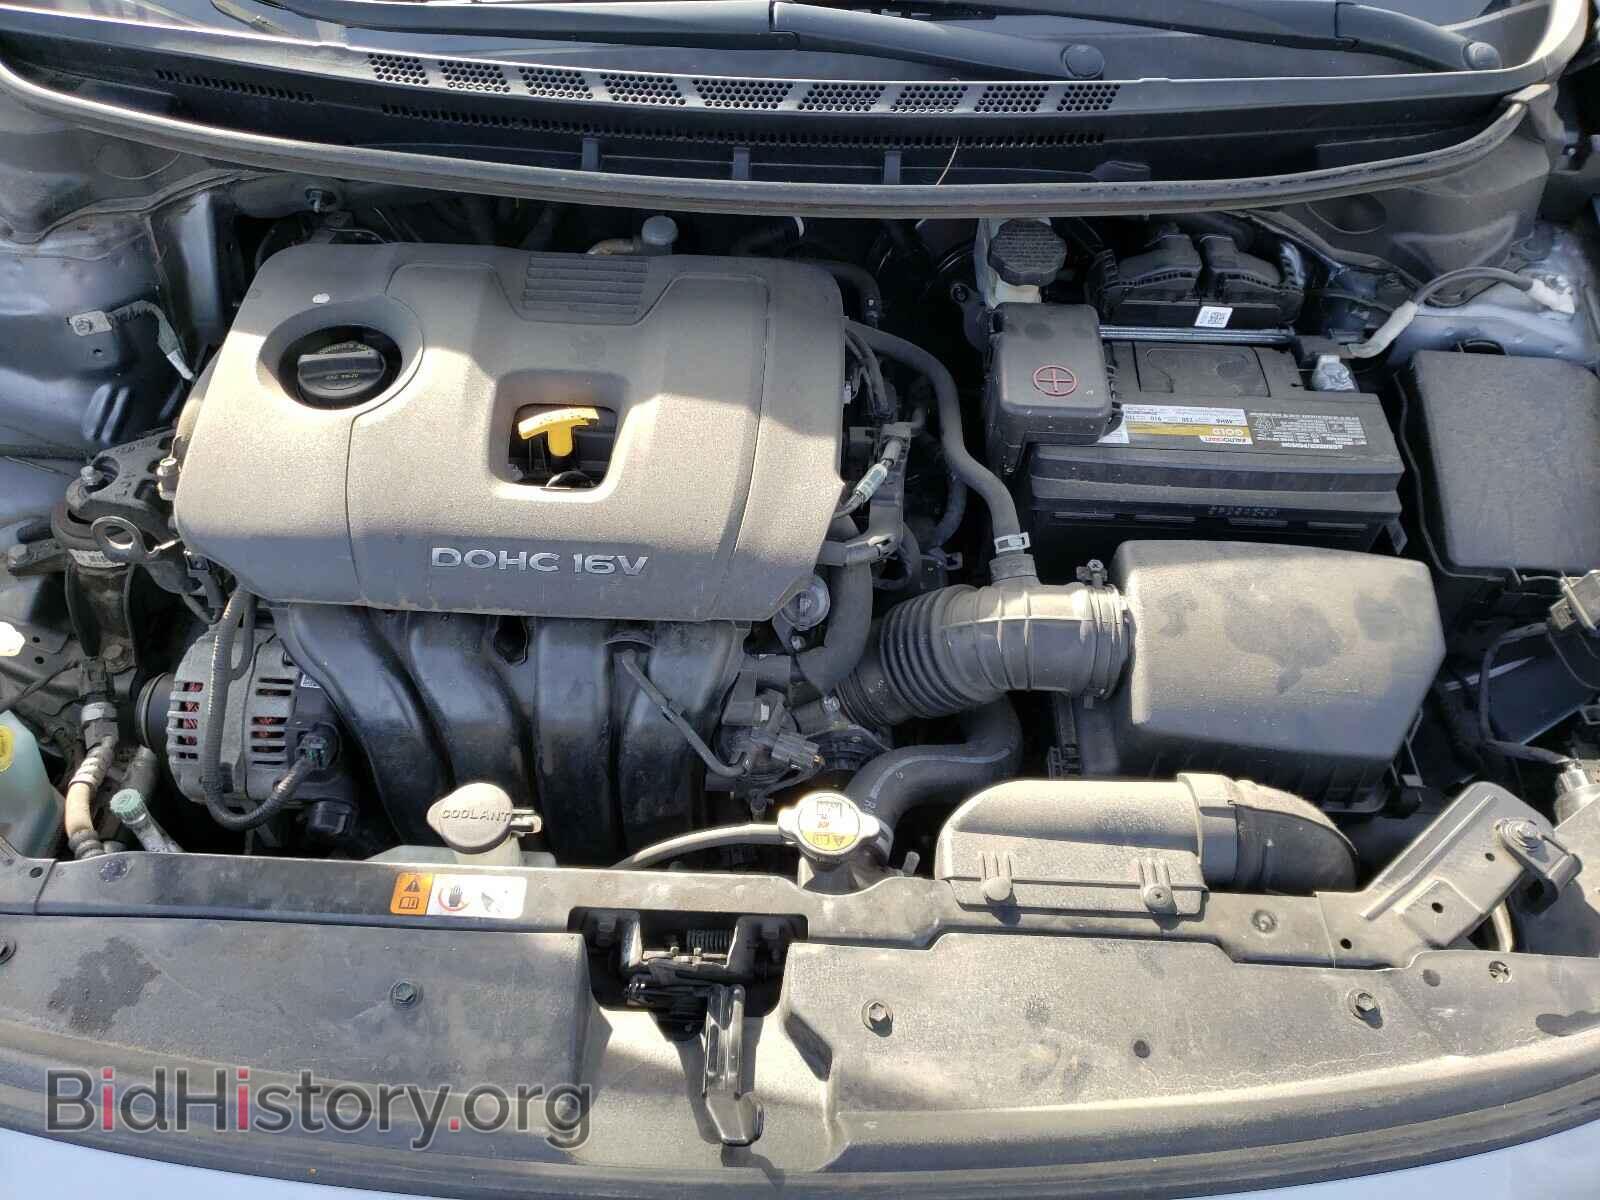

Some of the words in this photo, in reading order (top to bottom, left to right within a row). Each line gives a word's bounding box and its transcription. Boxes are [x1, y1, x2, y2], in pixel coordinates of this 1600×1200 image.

[1212, 428, 1244, 436] GOLD
[431, 547, 561, 573] DOHC
[572, 553, 649, 576] 16V
[441, 808, 511, 822] COOLANT
